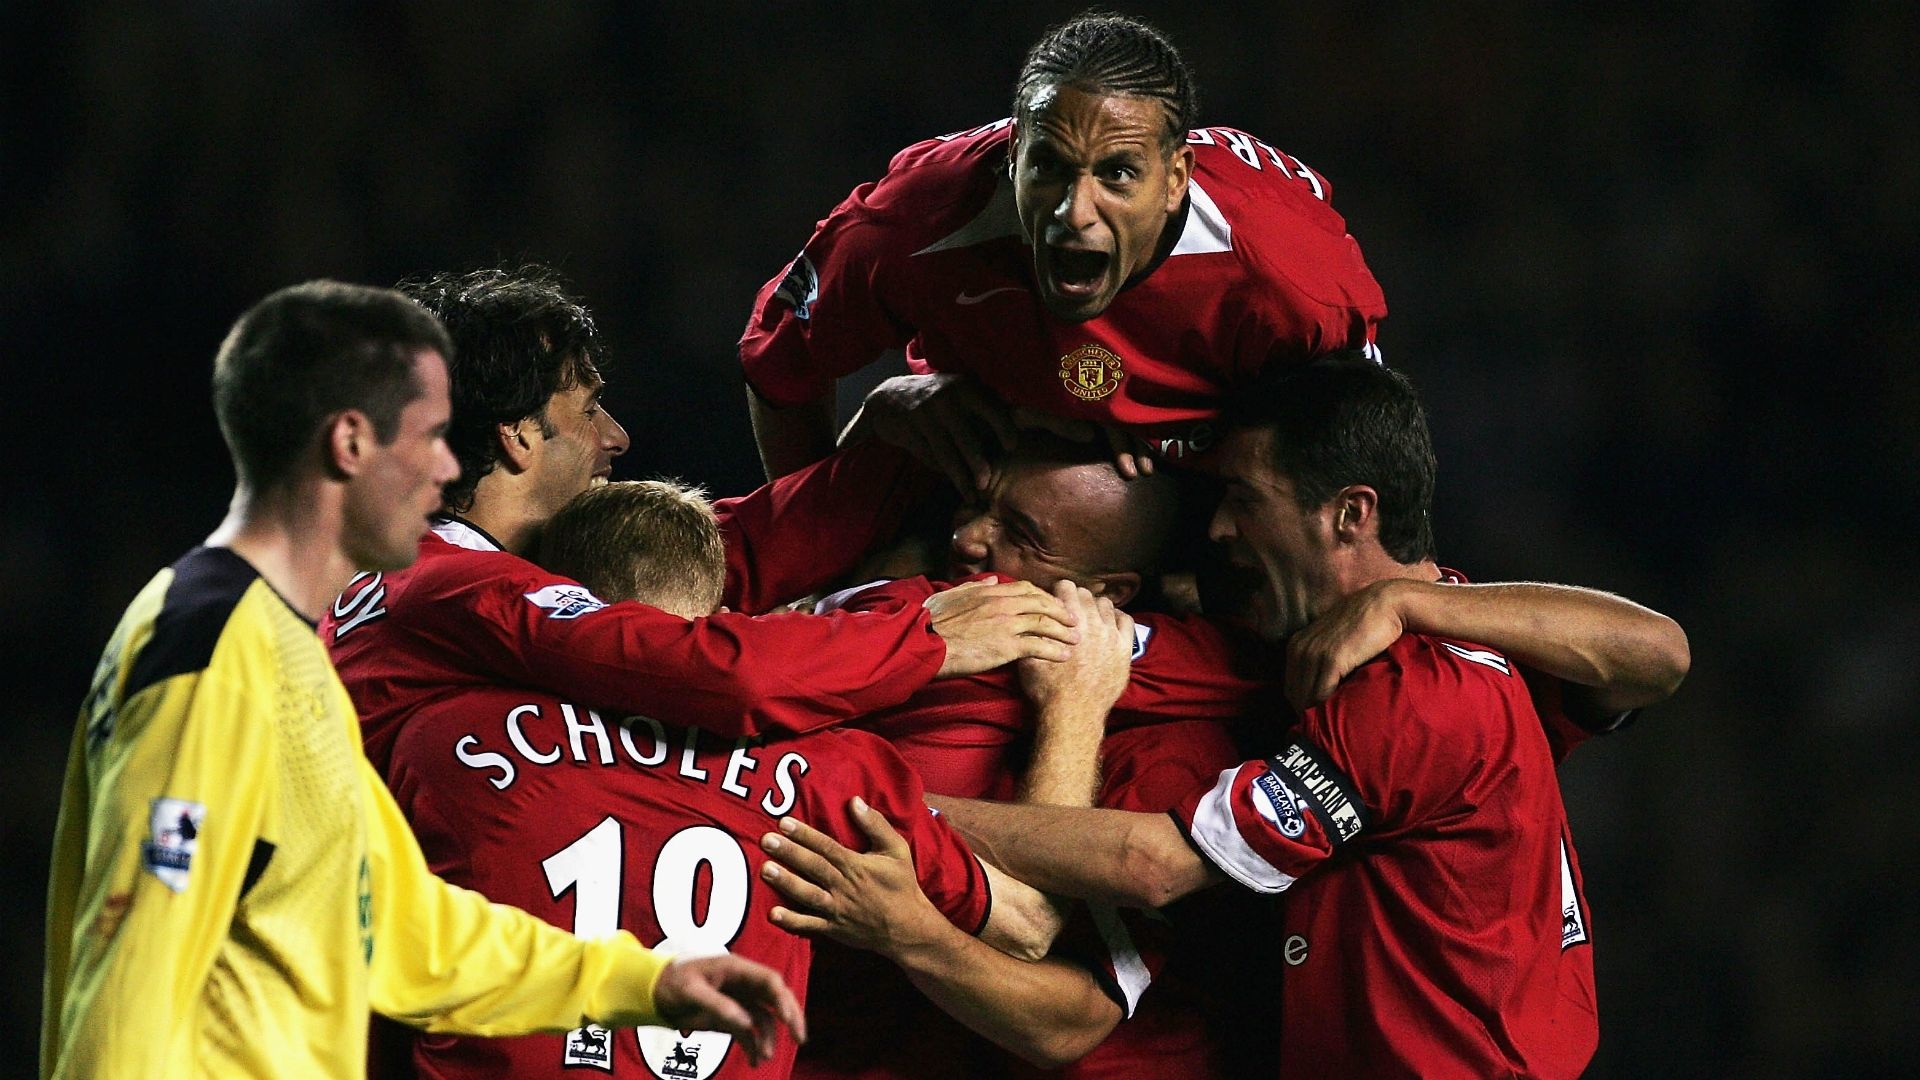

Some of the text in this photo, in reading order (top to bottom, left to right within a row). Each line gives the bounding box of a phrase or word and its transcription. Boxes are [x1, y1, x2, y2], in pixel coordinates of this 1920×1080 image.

[1073, 386, 1108, 397] UNITED
[455, 703, 809, 816] SCHOLES
[1286, 752, 1348, 815] CAPTAIN
[1264, 775, 1295, 818] BARCLAYS
[542, 815, 749, 1080] 18
